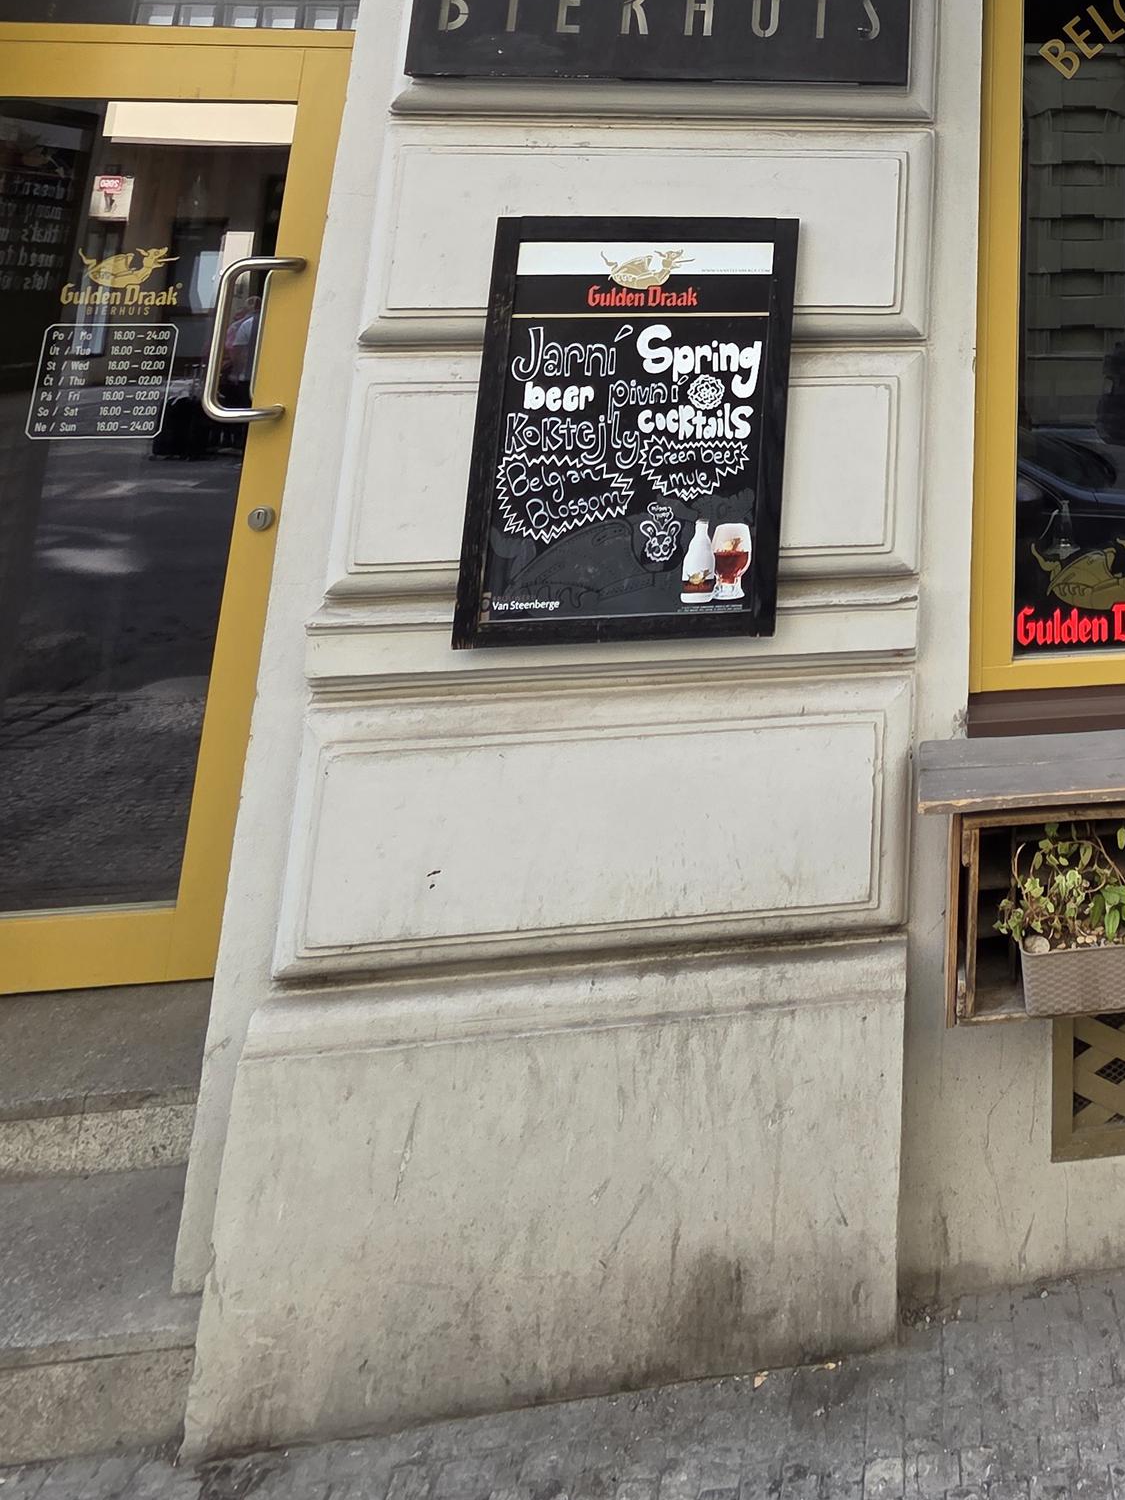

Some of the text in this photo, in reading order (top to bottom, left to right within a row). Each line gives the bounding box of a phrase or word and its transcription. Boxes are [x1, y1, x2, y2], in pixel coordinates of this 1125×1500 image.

[60, 283, 121, 305] Gulden
[587, 284, 698, 307] Gulden Draak
[86, 306, 150, 316] BIERHUIS
[53, 331, 64, 341] Po
[80, 331, 93, 341] Mo
[146, 330, 170, 340] 24.00
[143, 346, 168, 355] 02.00
[46, 361, 56, 371] St
[71, 361, 90, 371] Wed
[141, 361, 165, 370] 02.00
[637, 324, 763, 399] Spring
[138, 376, 162, 385] 02.00
[41, 391, 52, 401] Pá
[68, 391, 81, 401] Fri
[135, 391, 160, 400] 02.00
[523, 381, 595, 412] beer
[37, 407, 49, 416] So
[64, 407, 79, 416] Sat
[132, 406, 157, 416] 02.00
[34, 422, 47, 432] Ne
[60, 422, 77, 432] Sun
[129, 421, 155, 431] 24.00
[650, 445, 741, 467] Green beer
[506, 462, 600, 502] Belgian
[668, 470, 713, 488] mule
[525, 489, 628, 530] Blossom
[492, 599, 560, 611] Van Steenberge
[1017, 605, 1109, 647] Gulden
